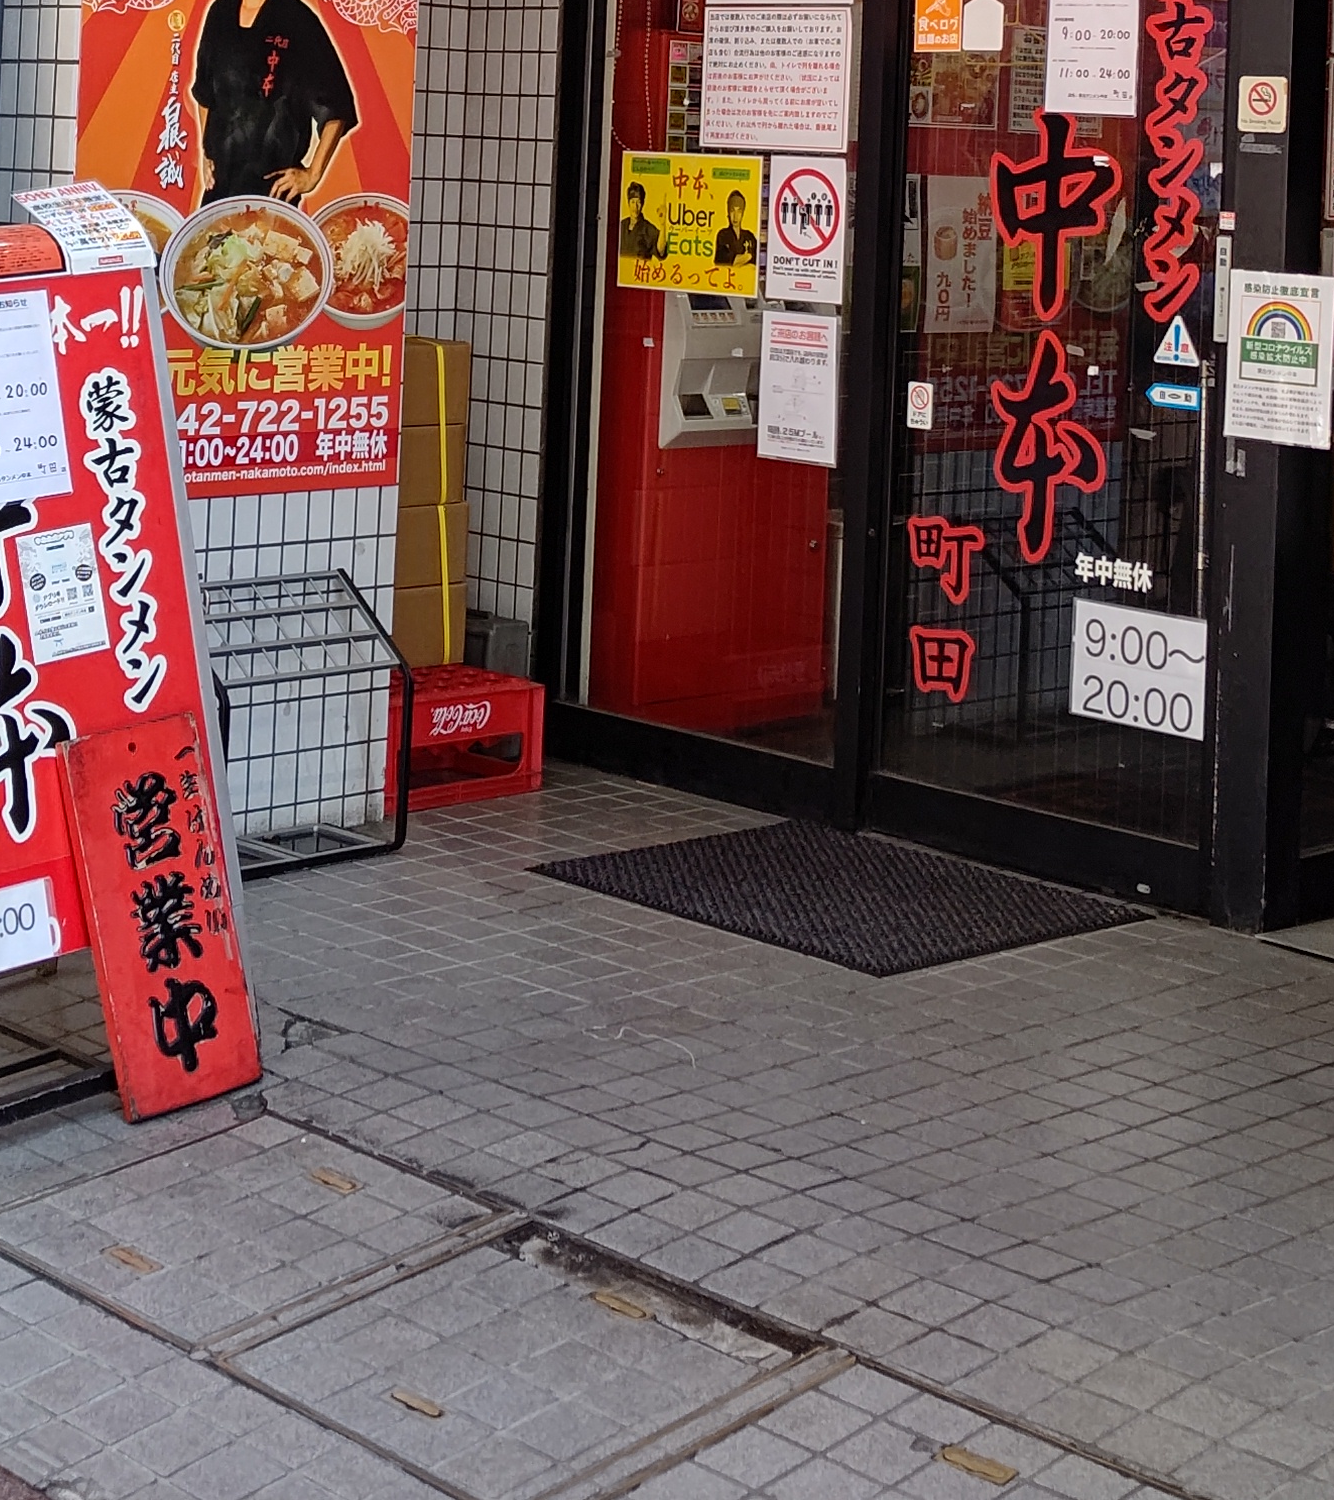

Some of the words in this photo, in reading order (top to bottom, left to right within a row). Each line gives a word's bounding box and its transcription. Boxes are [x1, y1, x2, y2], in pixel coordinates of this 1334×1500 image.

[917, 16, 959, 32] 食べログ
[1061, 26, 1092, 41] 9:00
[1100, 29, 1131, 40] 20:00
[1058, 67, 1090, 79] 11:00
[1099, 67, 1131, 80] 24:00
[668, 202, 715, 227] Uber
[667, 232, 714, 257] Eats
[773, 255, 800, 267] DON'T
[802, 257, 821, 268] CUT
[634, 258, 744, 291] 始めるってよ。
[1244, 282, 1320, 299] 感染防止徹底宣言
[990, 109, 1122, 562] 中本
[1245, 340, 1313, 356] 新型コロナウイルス
[167, 342, 393, 396] 元気に営業中!
[1249, 351, 1308, 365] 感染拡大防止中
[5, 382, 48, 399] 20:00
[13, 434, 58, 452] 24:00
[316, 429, 388, 461] 年中無休
[184, 459, 386, 484] otanmen-nakamoto.com/index.html
[82, 369, 166, 711] 蒙古タンメン
[1074, 553, 1154, 593] 年中無休
[908, 517, 985, 702] 町田
[1083, 674, 1194, 733] 20:00
[109, 770, 219, 1073] 営業中
